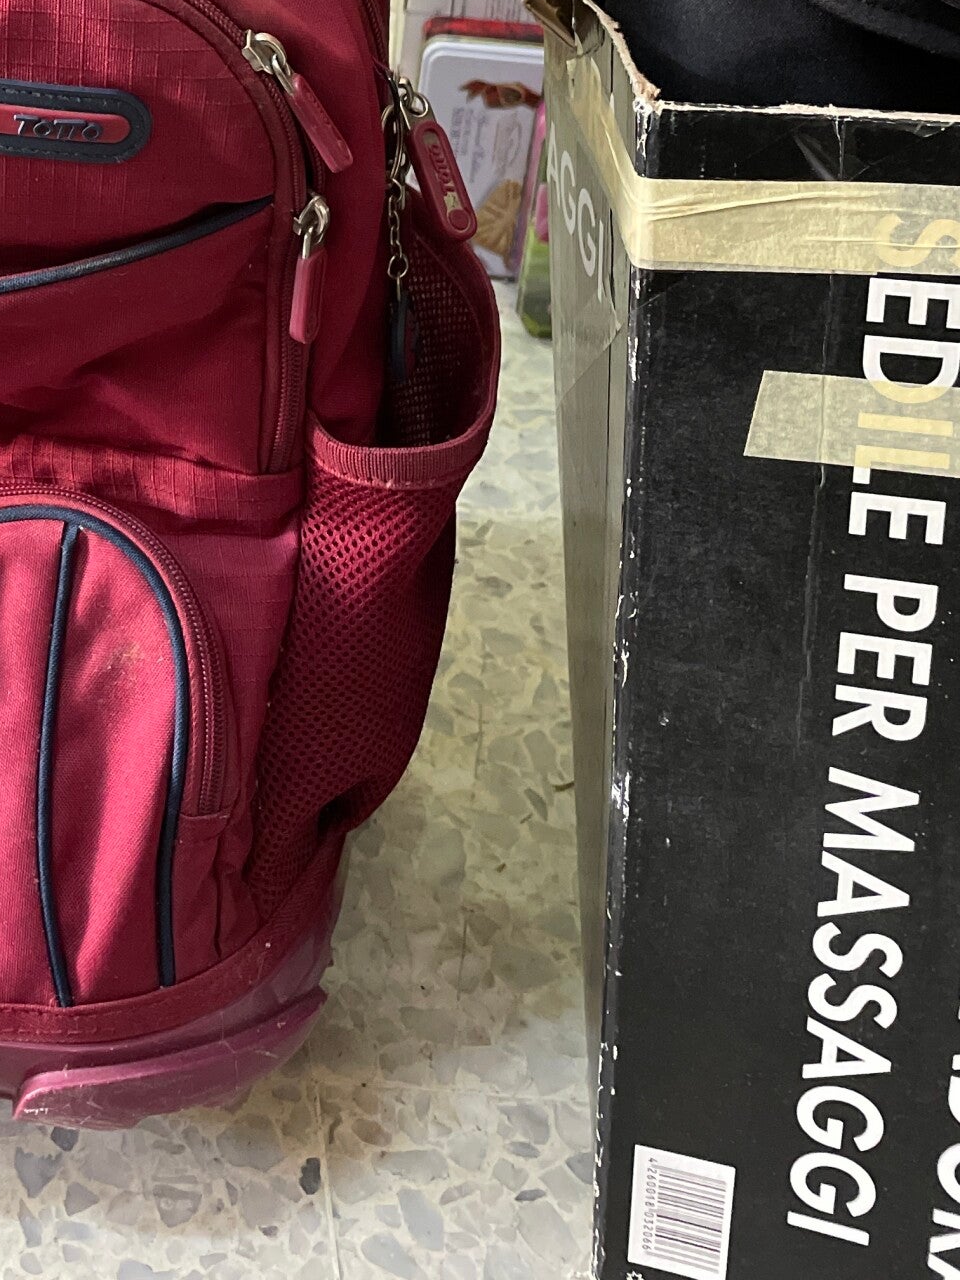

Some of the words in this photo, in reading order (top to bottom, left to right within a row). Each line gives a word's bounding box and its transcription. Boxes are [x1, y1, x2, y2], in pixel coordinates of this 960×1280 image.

[851, 211, 960, 548] SEDILE
[831, 573, 939, 743] PER
[786, 765, 920, 1247] MASSAGGI
